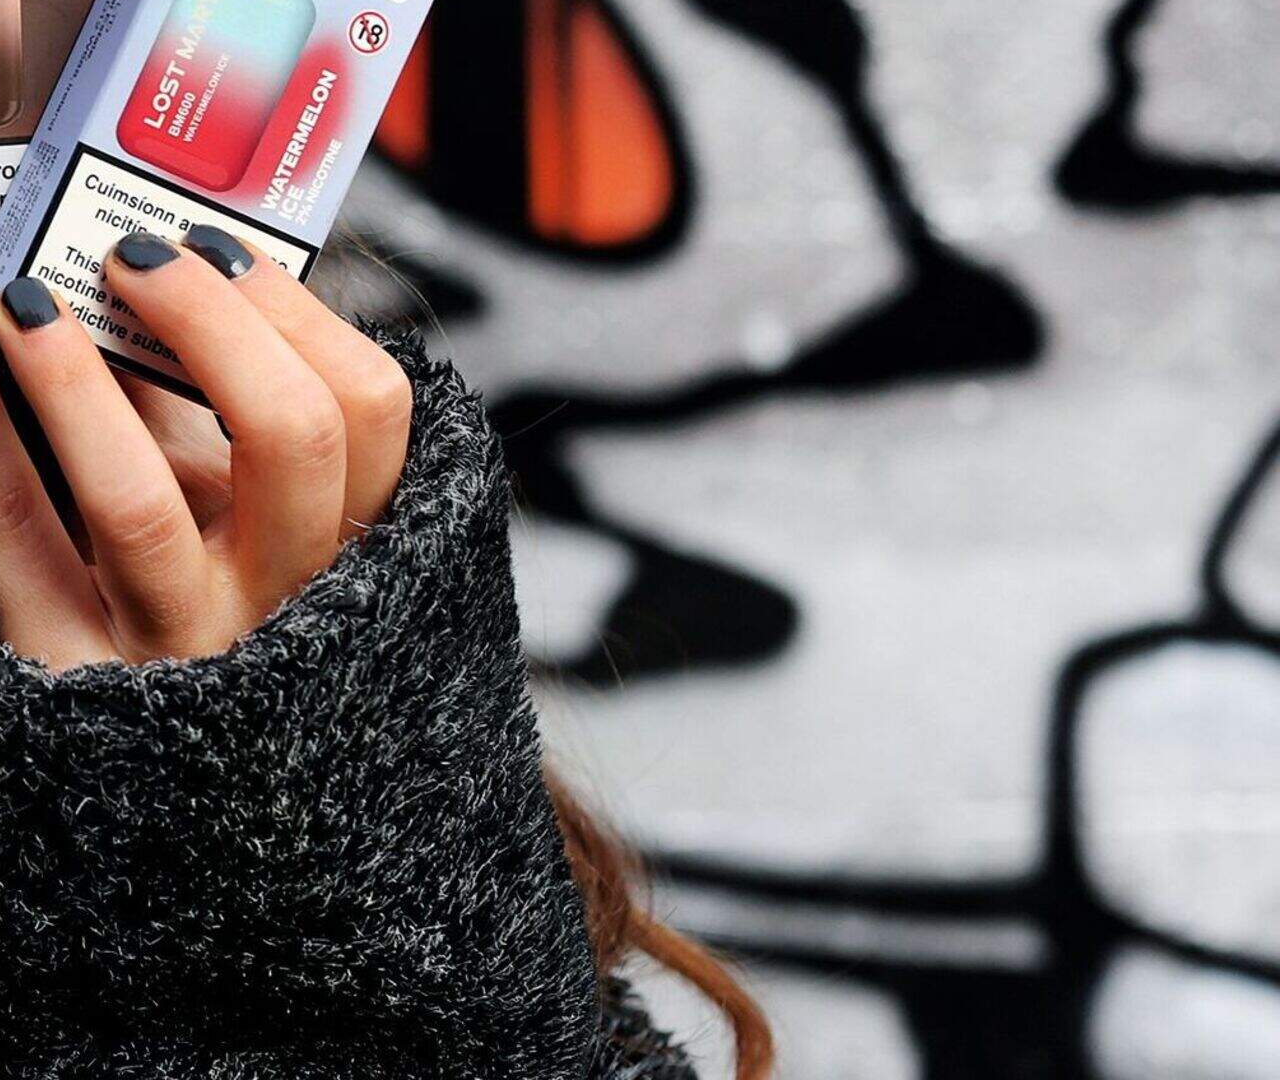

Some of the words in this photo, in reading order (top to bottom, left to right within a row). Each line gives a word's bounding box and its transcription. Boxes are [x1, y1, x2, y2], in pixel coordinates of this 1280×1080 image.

[143, 59, 186, 130] LOST
[167, 91, 197, 138] BM600
[183, 72, 223, 143] WATERMELON
[259, 68, 339, 211] WATERMELON
[306, 137, 344, 204] NICOTINE
[84, 173, 176, 226] Cuimsíonn
[277, 183, 305, 220] ICE
[38, 265, 107, 304] nicotine
[64, 245, 102, 274] This
[69, 301, 129, 340] dictive
